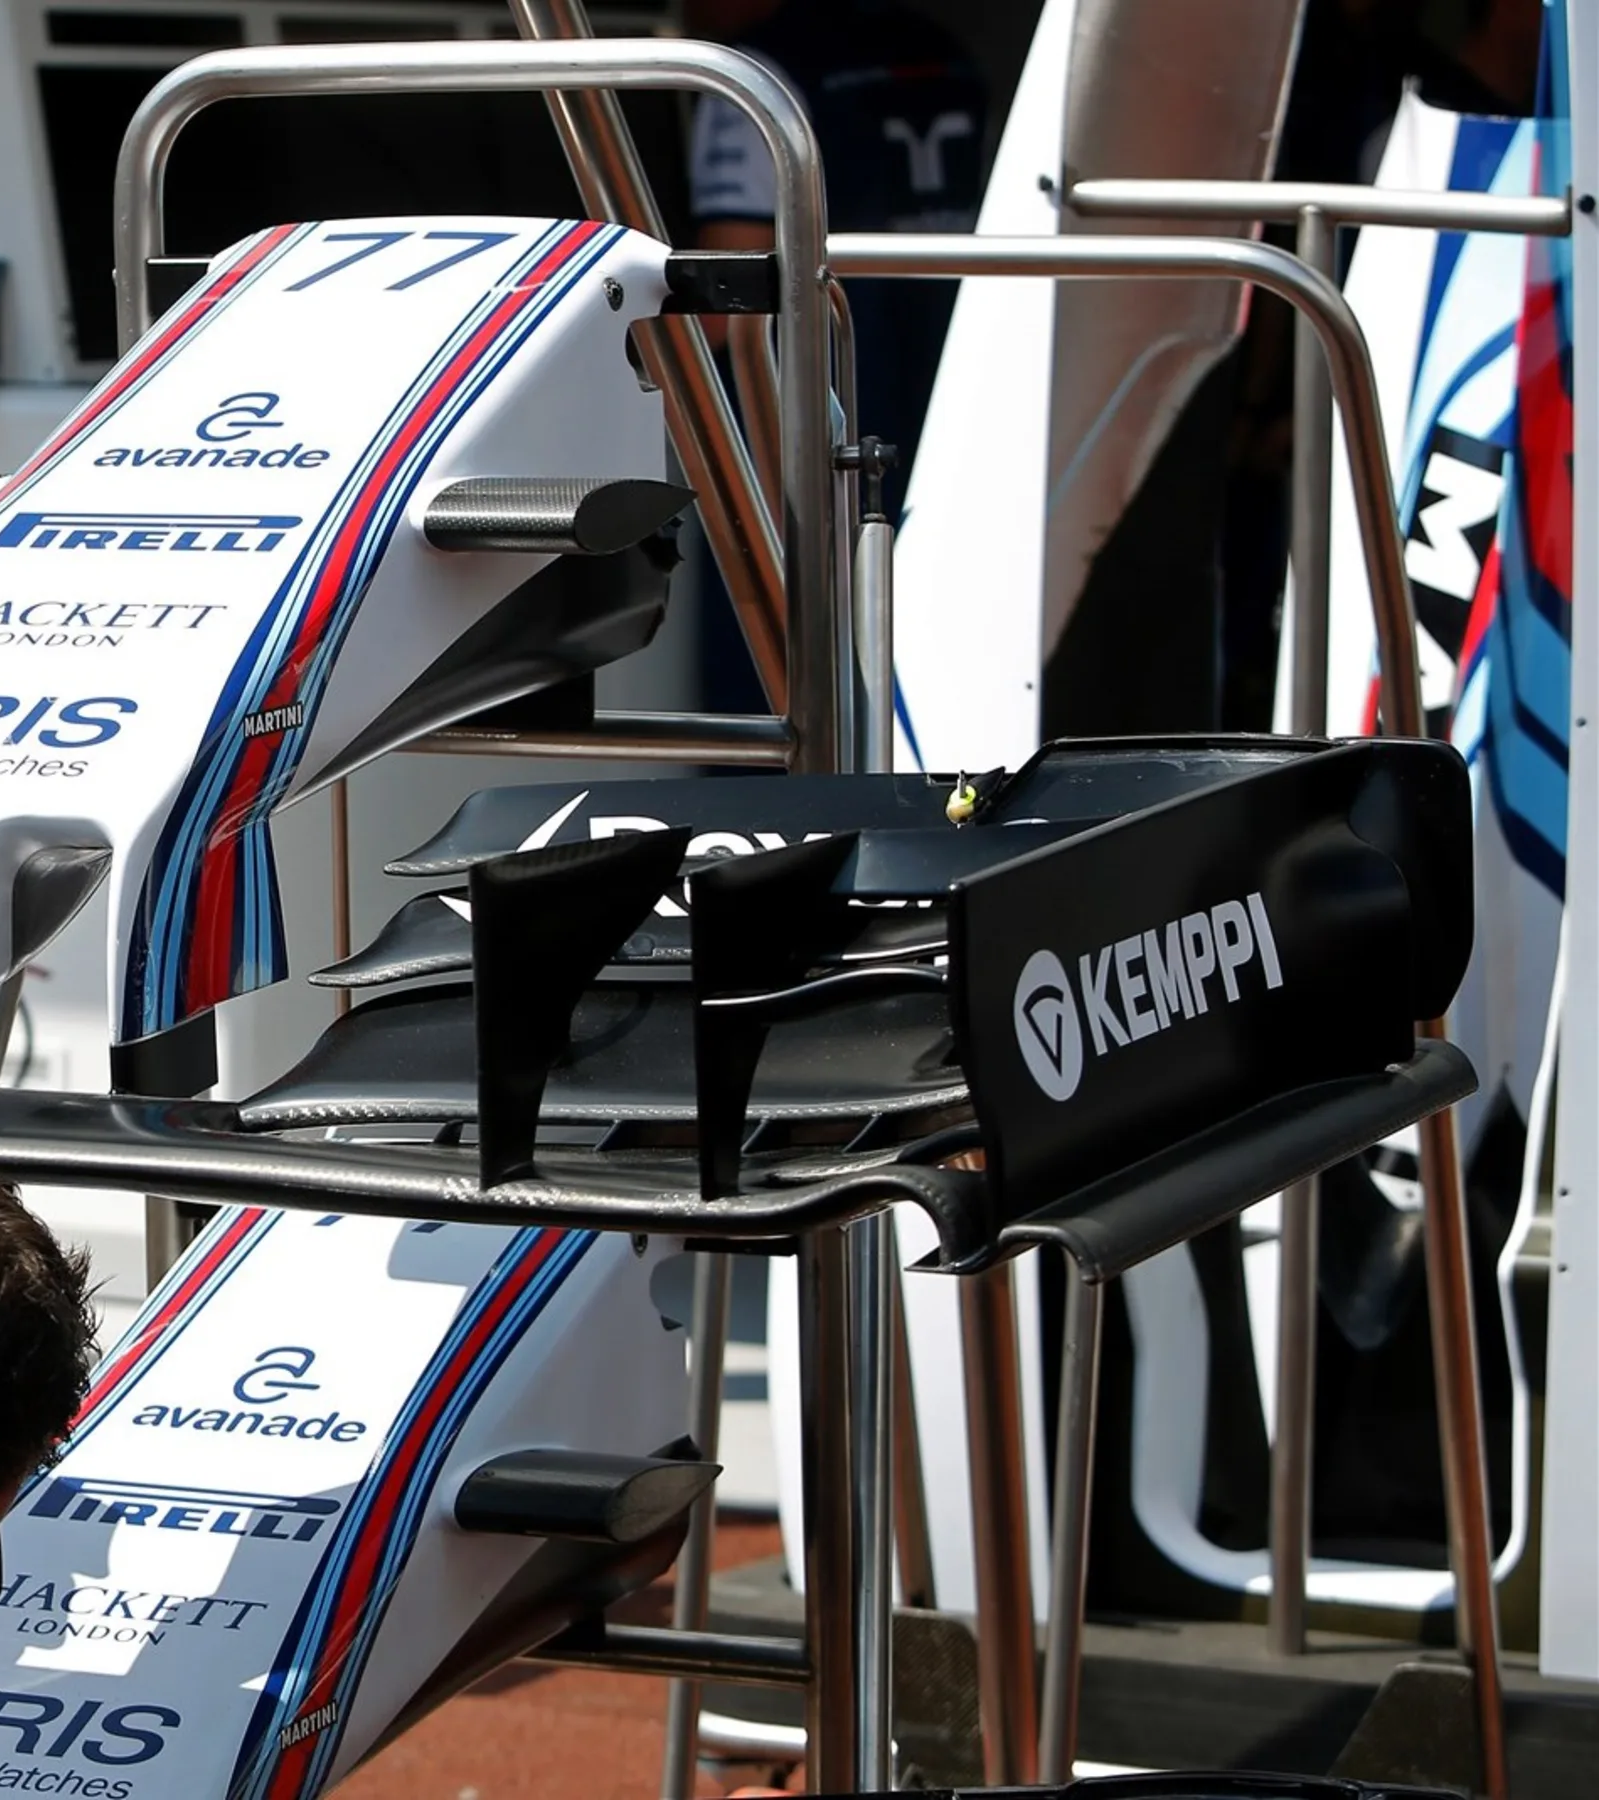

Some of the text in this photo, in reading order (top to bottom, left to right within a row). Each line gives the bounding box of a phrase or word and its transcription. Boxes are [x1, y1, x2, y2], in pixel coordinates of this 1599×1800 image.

[283, 231, 519, 291] 77
[93, 443, 331, 469] avanade
[244, 704, 302, 738] MARTINI
[1079, 892, 1284, 1057] KEMPPI
[132, 1402, 367, 1443] avanade
[28, 1476, 341, 1542] PIRELLI
[16, 1617, 166, 1647] LONDON
[280, 1702, 338, 1750] MARTINI
